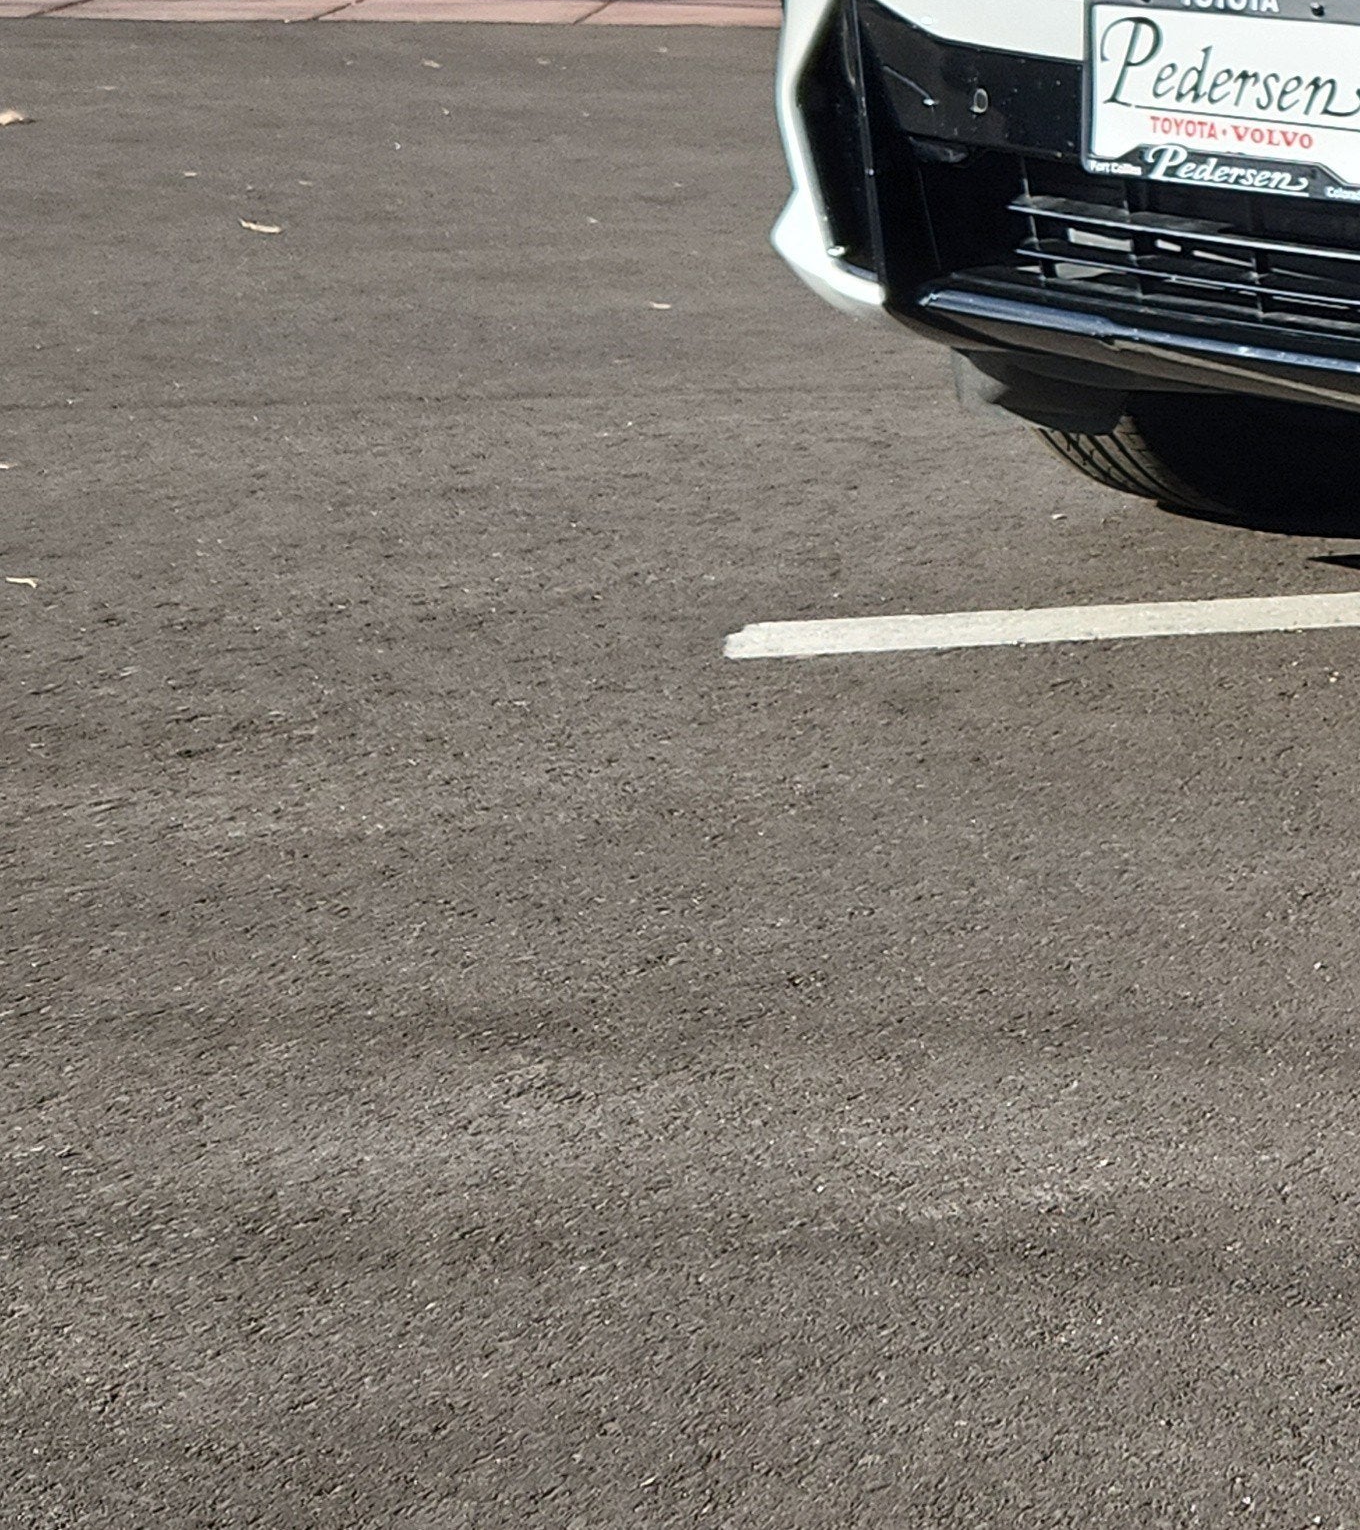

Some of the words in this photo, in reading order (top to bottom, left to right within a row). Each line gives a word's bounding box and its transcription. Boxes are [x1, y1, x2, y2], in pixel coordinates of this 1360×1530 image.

[1150, 115, 1218, 139] TOYOTA
[1230, 124, 1314, 150] VOLVO
[1145, 142, 1309, 192] Pedersen
